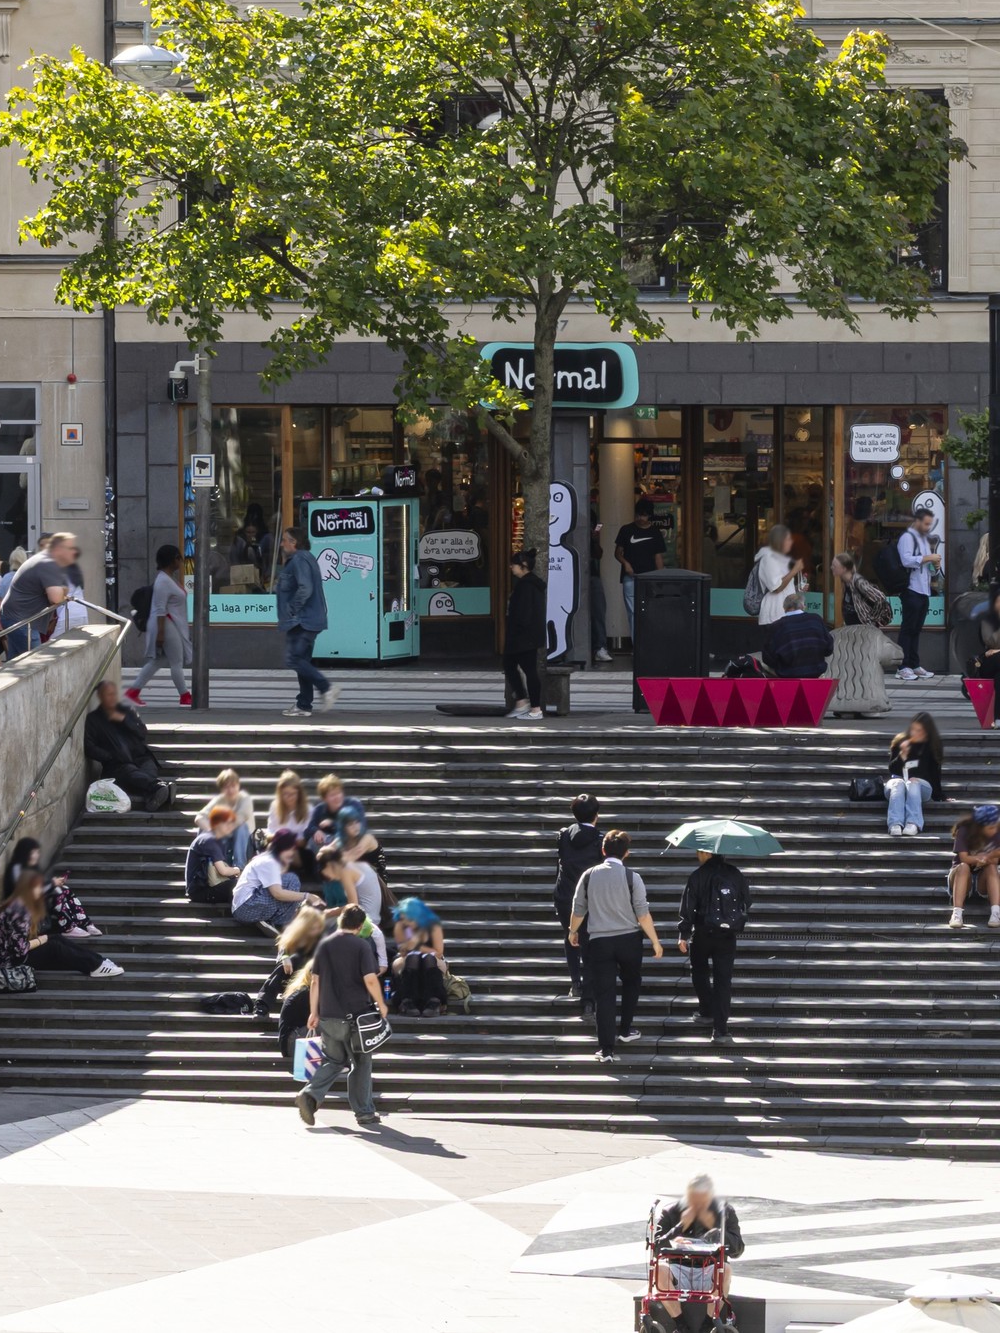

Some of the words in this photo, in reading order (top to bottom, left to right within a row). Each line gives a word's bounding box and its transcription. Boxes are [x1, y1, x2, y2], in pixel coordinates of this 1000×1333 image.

[317, 512, 368, 532] Normal
[424, 537, 439, 545] Var
[450, 536, 463, 545] alla
[423, 546, 440, 555] dyra
[441, 546, 475, 555] varorna?
[221, 602, 241, 614] låga
[244, 602, 274, 614] priser
